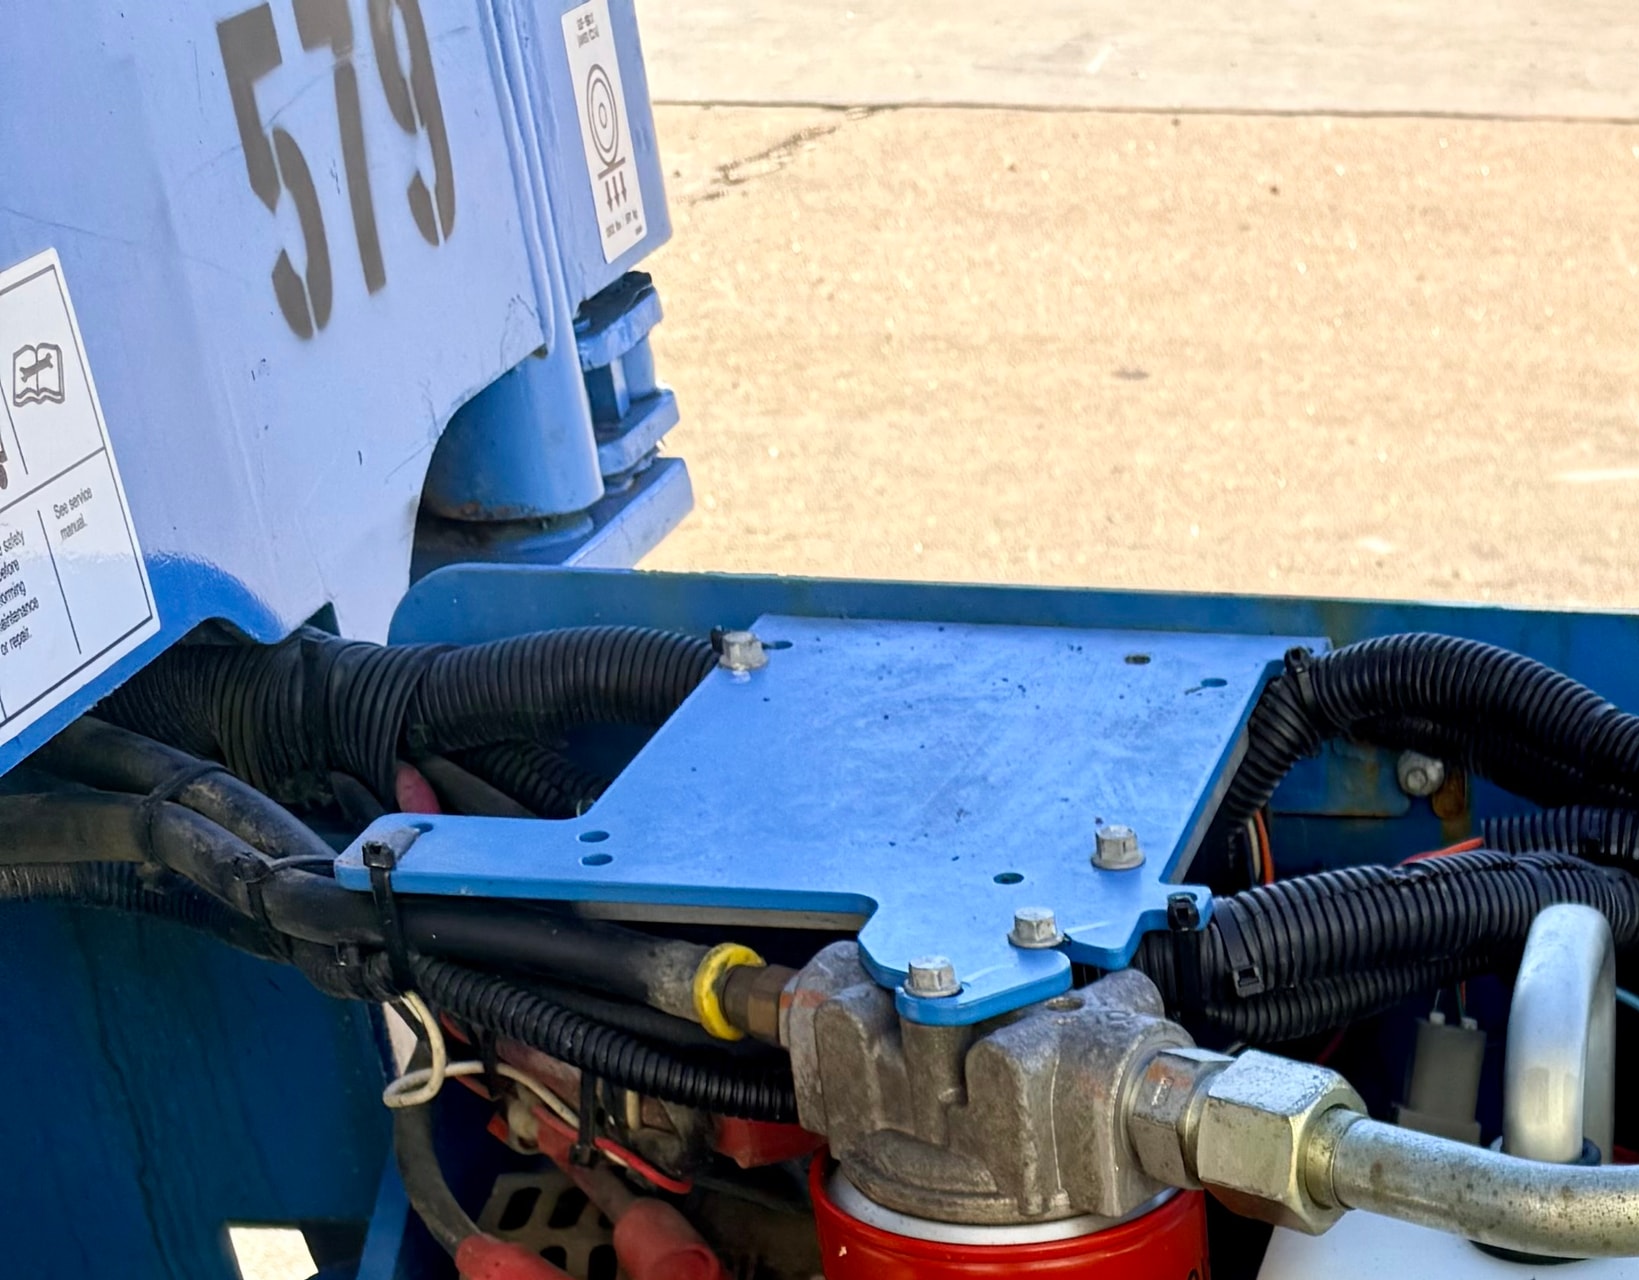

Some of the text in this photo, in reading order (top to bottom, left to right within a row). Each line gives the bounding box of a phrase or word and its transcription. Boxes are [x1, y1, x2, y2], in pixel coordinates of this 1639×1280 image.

[216, 0, 456, 341] 579
[53, 487, 93, 520] See service
[3, 529, 25, 552] safety
